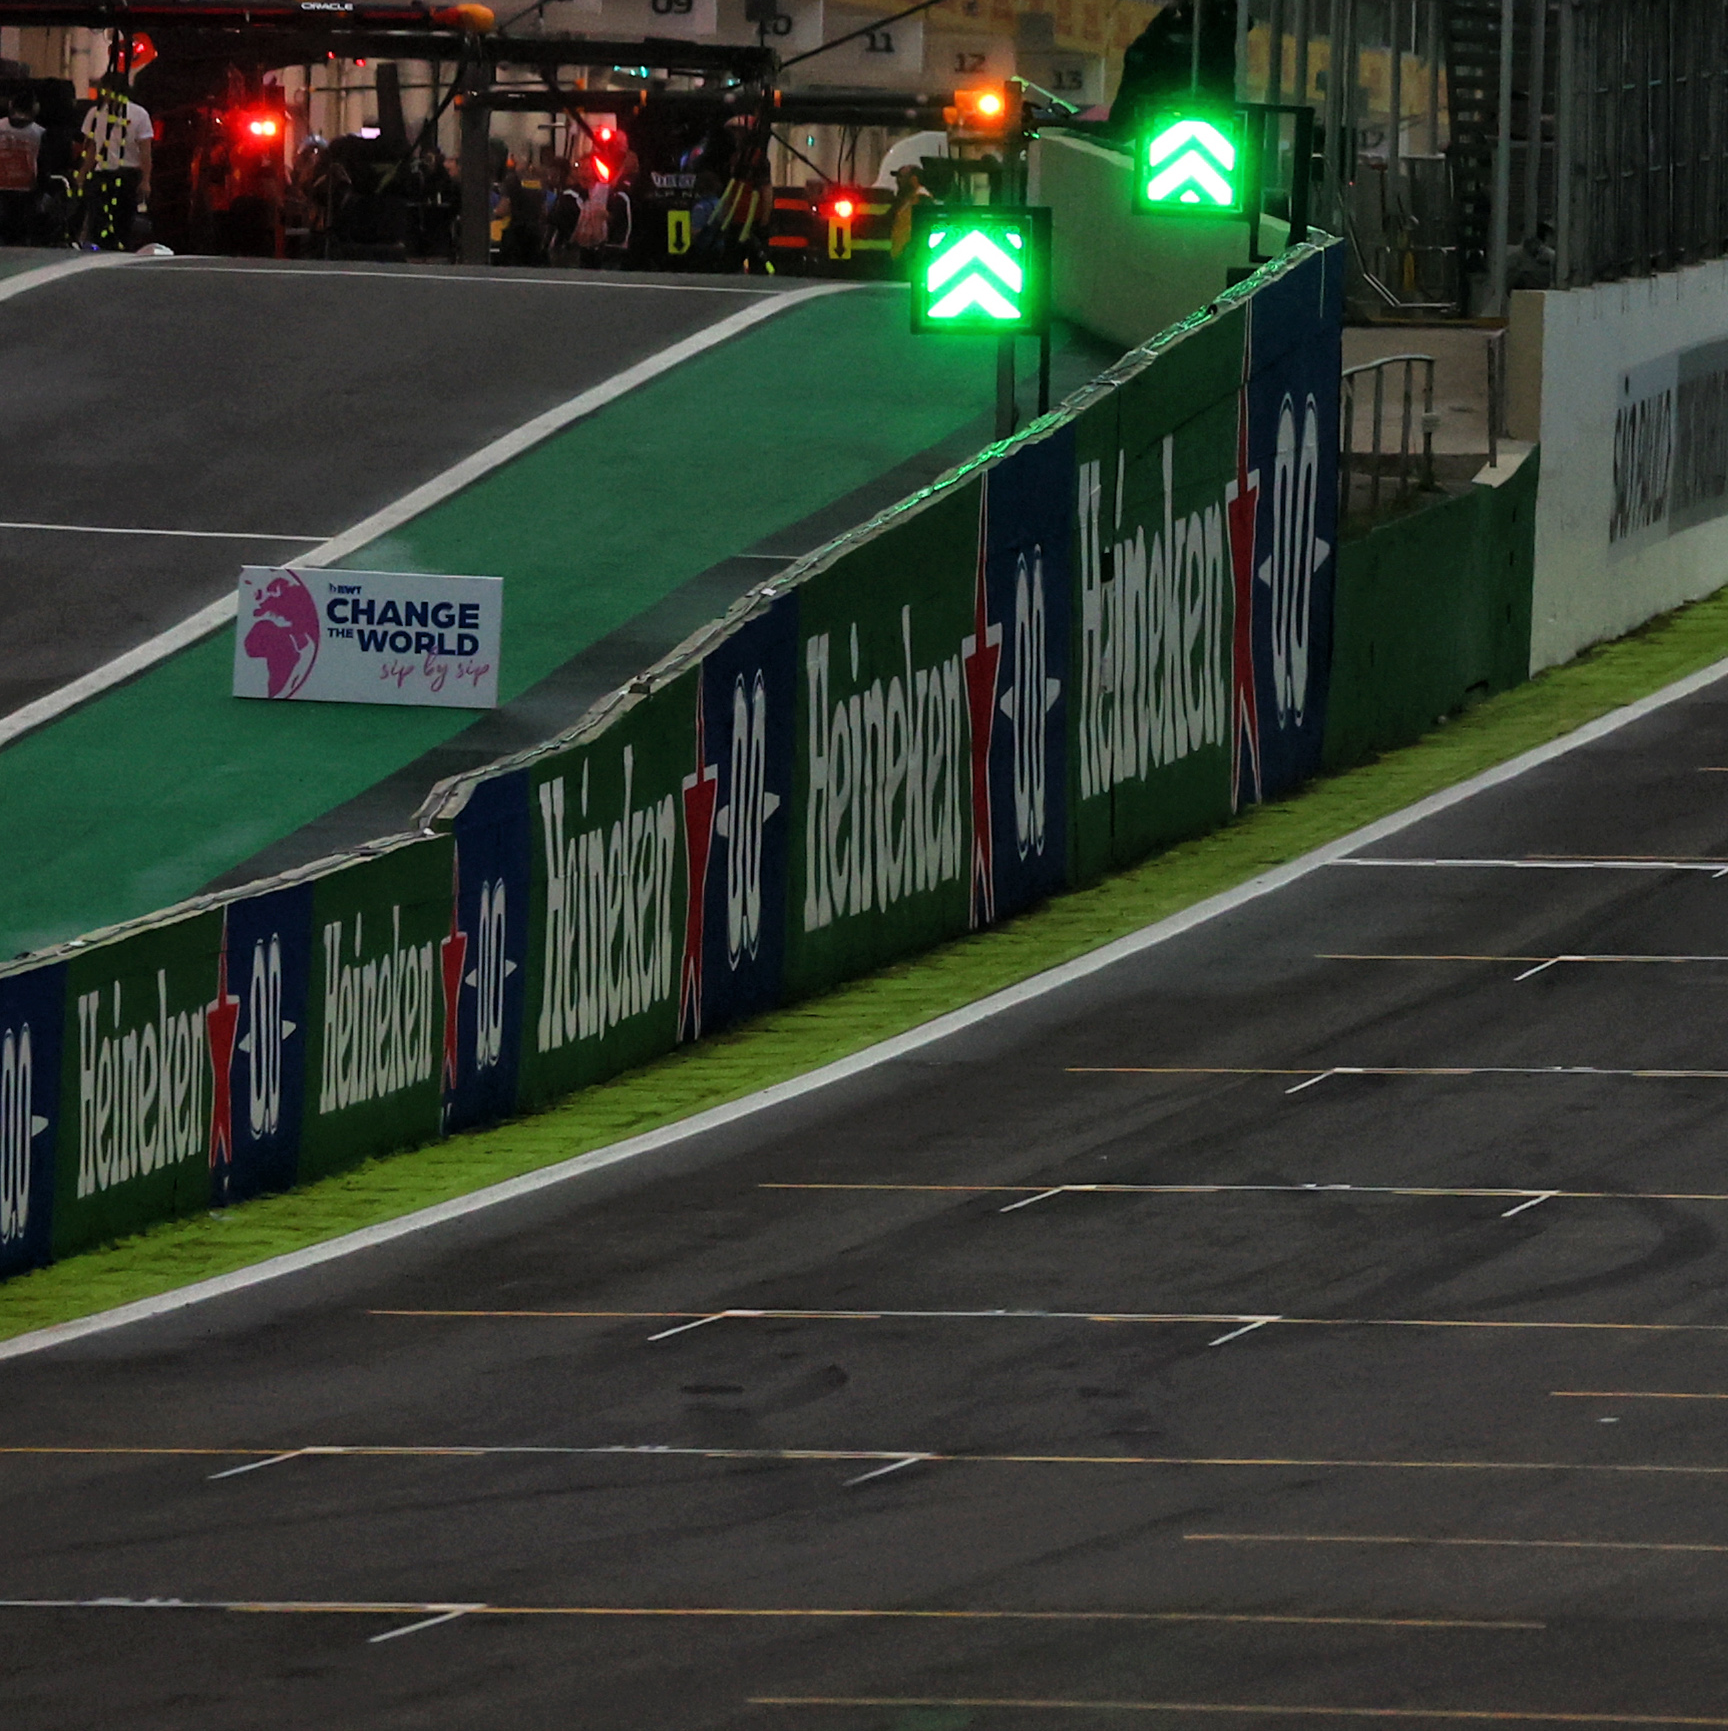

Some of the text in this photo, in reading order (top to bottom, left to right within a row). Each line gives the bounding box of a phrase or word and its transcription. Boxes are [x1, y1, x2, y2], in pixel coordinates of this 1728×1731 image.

[300, 1, 354, 12] ORACLE
[326, 597, 480, 630] CHANGE
[327, 627, 480, 657] THE WORLD
[379, 644, 490, 693] sip by sip
[1077, 433, 1226, 801] Heineken
[803, 603, 963, 933] Heineken
[537, 743, 676, 1054] Heineken
[76, 968, 205, 1200] Heineken
[318, 904, 434, 1116] Heineken
